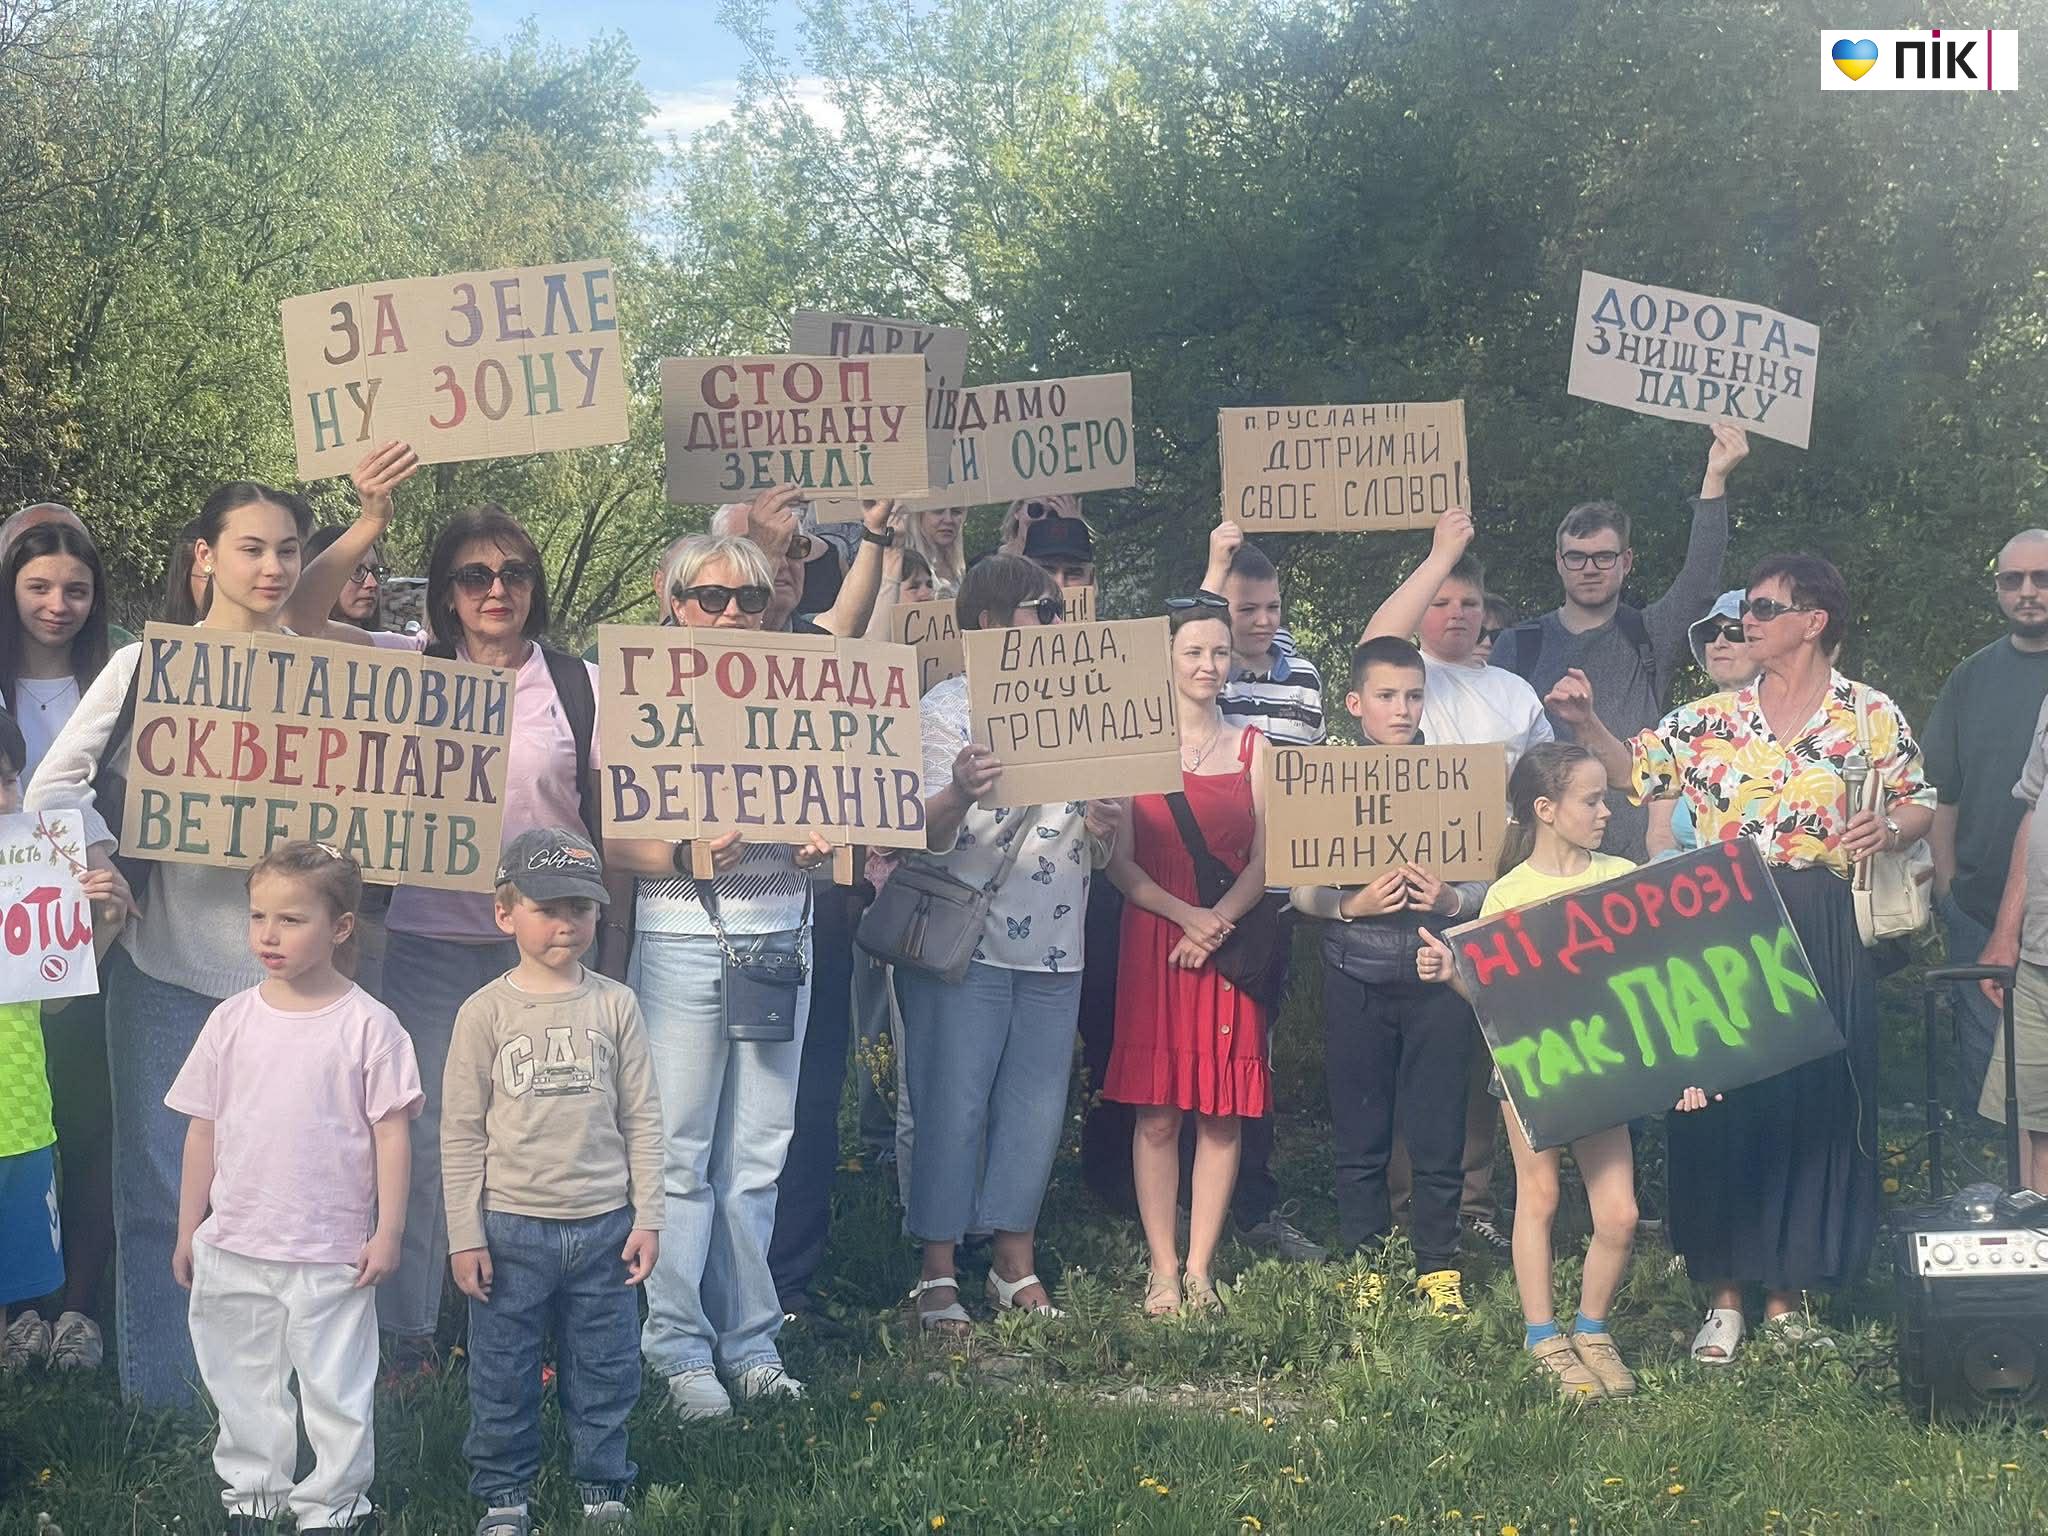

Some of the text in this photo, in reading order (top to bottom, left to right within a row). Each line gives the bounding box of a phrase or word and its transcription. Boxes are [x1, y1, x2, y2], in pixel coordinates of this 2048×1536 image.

[324, 269, 617, 366] ЗА ЗЕЛЕ
[701, 362, 873, 410] СТОП
[1586, 326, 1803, 399] ЗНИЩЕННЯ
[307, 347, 605, 452] НУ ЗОНУ
[958, 383, 1067, 434] ДАМО
[1636, 368, 1778, 423] ПАРКУ
[683, 405, 907, 453] ДЕРИБАНУ
[1012, 417, 1128, 480] ОЗЕРО
[1262, 424, 1440, 473] ДОТРИМАЙ
[1345, 460, 1464, 517] СЛОВО!
[904, 609, 962, 646] СЛА
[142, 638, 509, 737] КАШТАНОВИЙ
[619, 647, 911, 709] ГРОМАДА
[631, 703, 901, 758] ЗА ПАРК
[987, 679, 1177, 753] ГРОМАДУ!
[1291, 810, 1484, 869] ШАНХАЙ!
[1355, 794, 1394, 827] НЕ
[1493, 925, 1819, 1099] ТАК ПАРК
[500, 1026, 619, 1100] GAP
